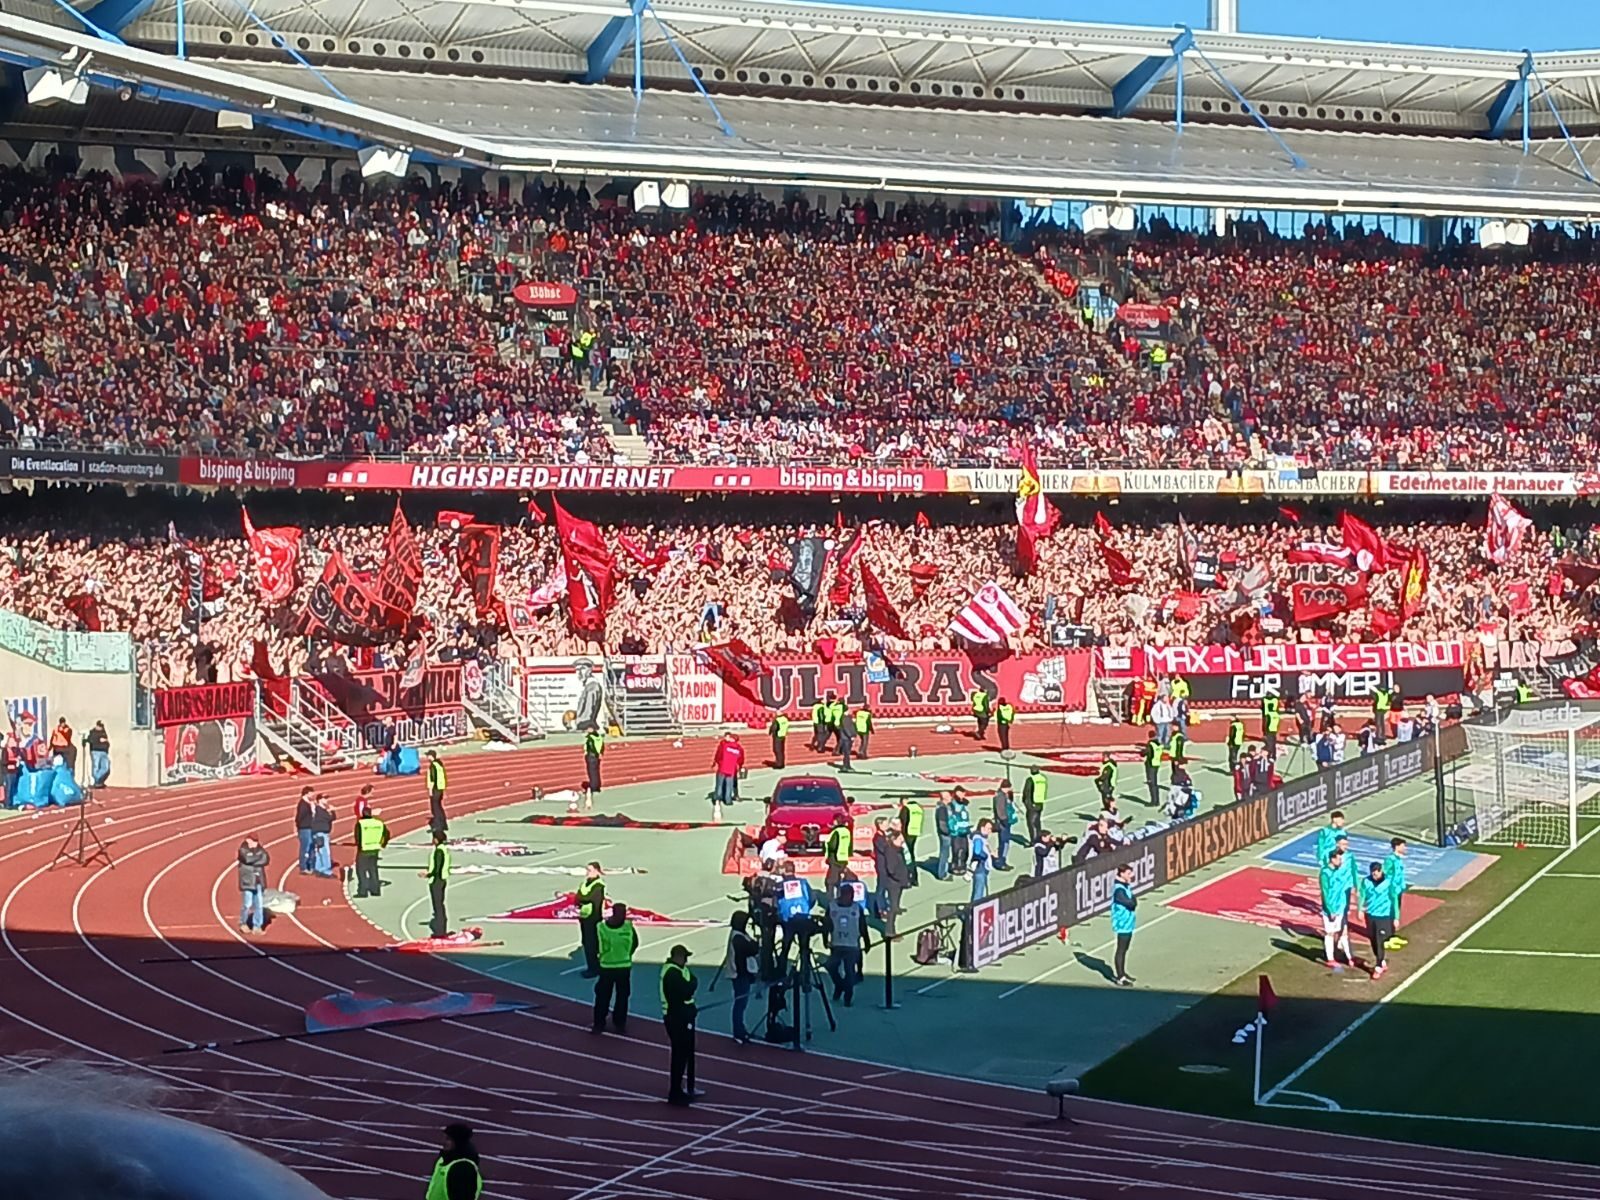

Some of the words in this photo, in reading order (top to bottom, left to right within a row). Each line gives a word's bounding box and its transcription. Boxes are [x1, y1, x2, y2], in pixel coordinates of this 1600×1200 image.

[11, 457, 25, 470] Die
[26, 457, 79, 472] Eventlocation
[410, 465, 675, 487] HIGHSPEED-INTERNET
[1123, 472, 1215, 490] KULMBACHER
[1389, 474, 1487, 491] Edelmetalle
[1493, 477, 1565, 491] Hanauer
[671, 681, 717, 697] STADION
[755, 661, 999, 708] ULTRAS
[1232, 674, 1281, 698] FÜR
[1166, 797, 1270, 881] EXPRESSDRUCK
